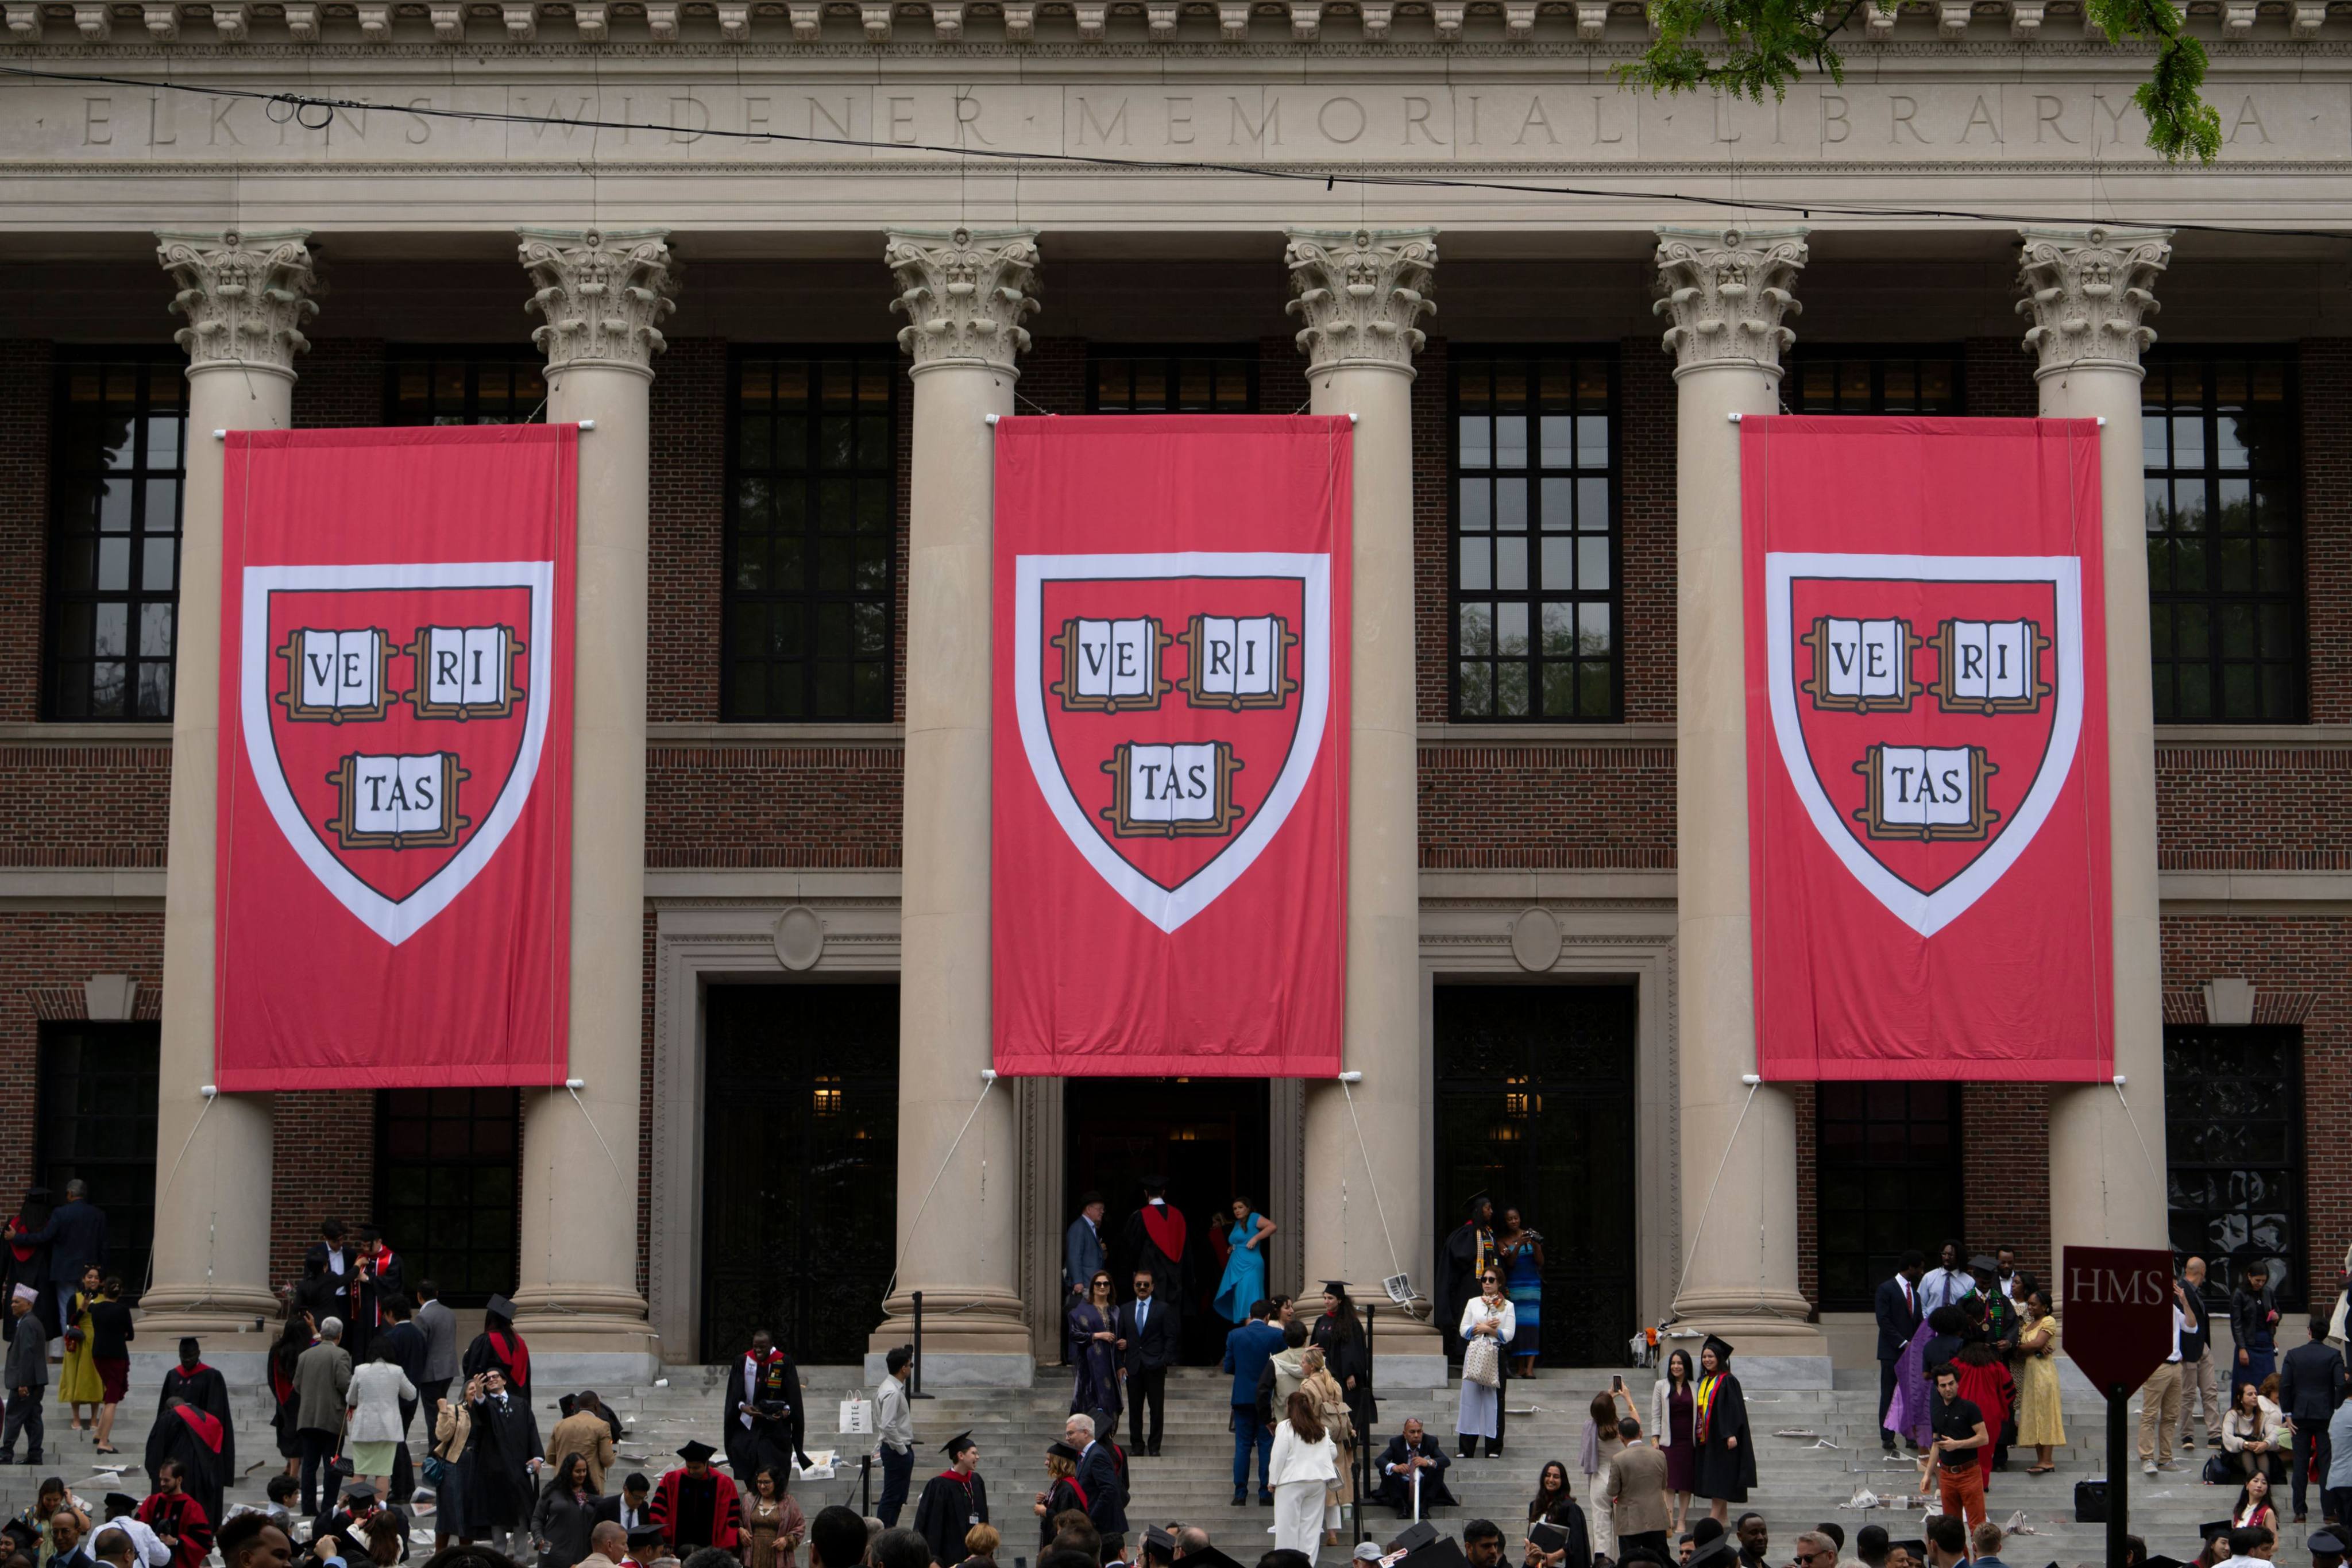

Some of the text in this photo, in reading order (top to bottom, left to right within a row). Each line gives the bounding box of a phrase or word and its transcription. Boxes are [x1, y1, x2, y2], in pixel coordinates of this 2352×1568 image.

[82, 94, 2275, 146] ELKINS WIDENER MEMORIAL LIBRARY A
[307, 652, 362, 688] VE
[437, 650, 483, 685] RI
[1081, 642, 1137, 677] VE
[1210, 640, 1256, 675] RI
[1831, 642, 1887, 678] VE
[1961, 643, 2008, 679] RI
[364, 774, 434, 811] TAS
[1139, 763, 1207, 800] TAS
[1891, 766, 1962, 804] TAS
[2070, 1267, 2164, 1306] HMS
[851, 1405, 860, 1432] TATTE
